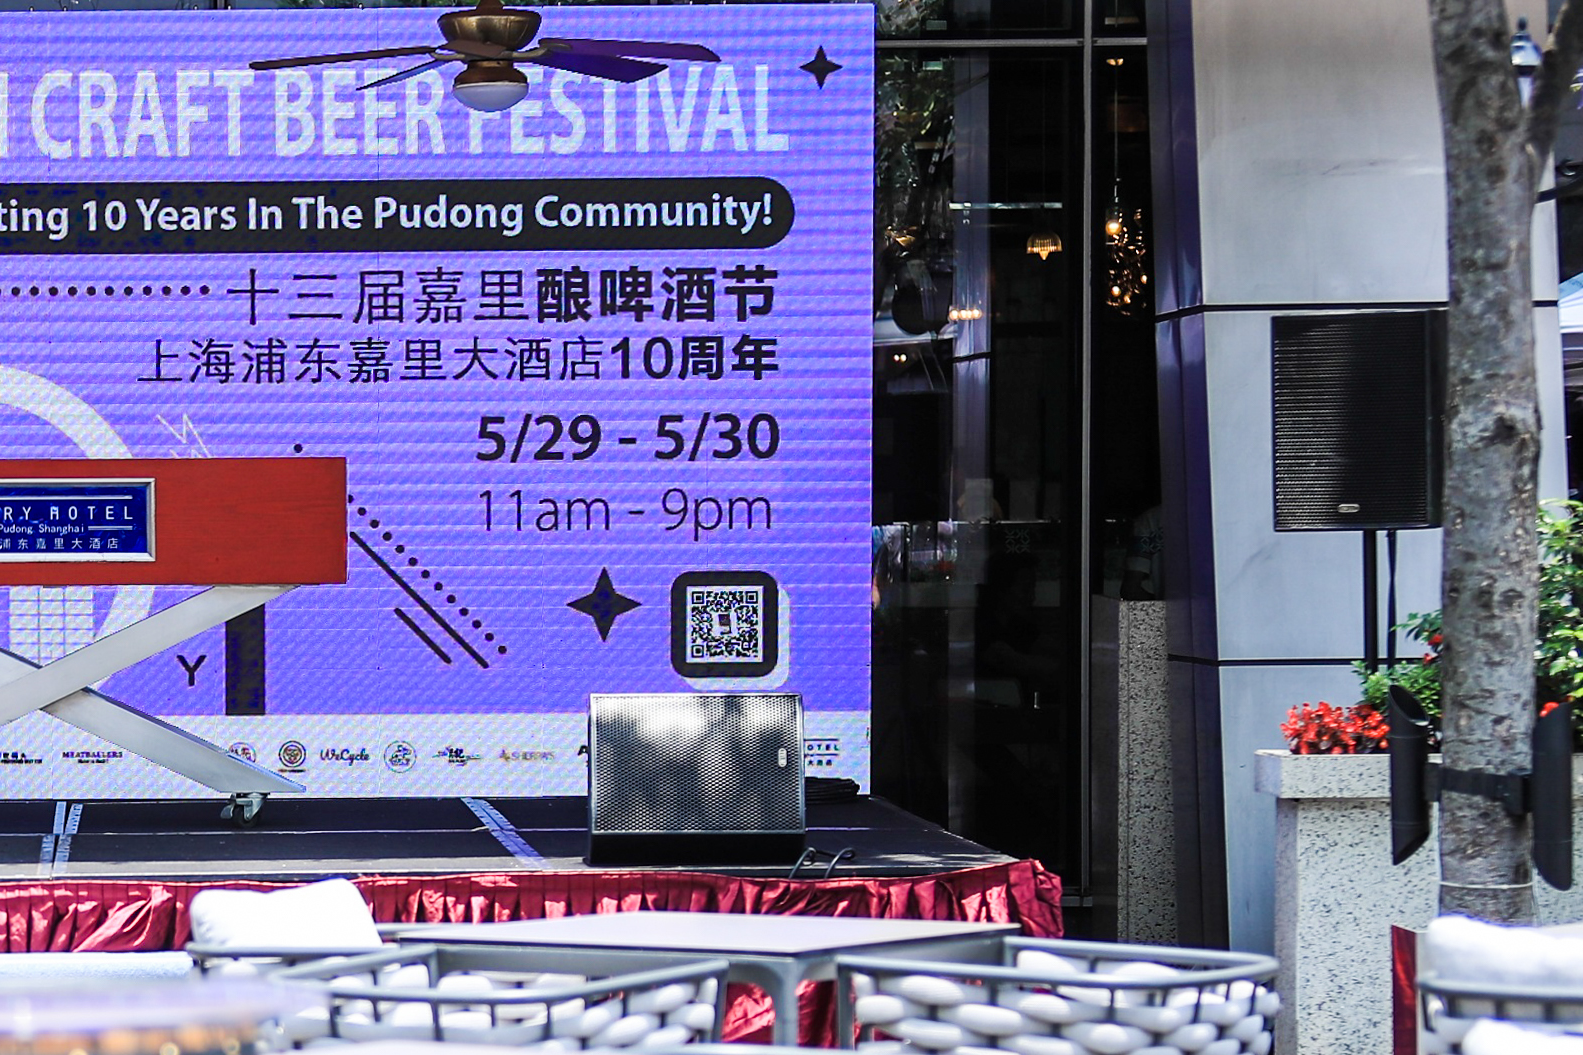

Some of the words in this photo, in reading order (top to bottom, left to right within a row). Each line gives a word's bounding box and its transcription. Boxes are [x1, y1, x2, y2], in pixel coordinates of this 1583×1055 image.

[31, 70, 255, 159] CRAFT
[275, 66, 446, 157] BEER
[82, 201, 127, 232] 10
[136, 199, 238, 232] Years
[249, 199, 284, 231] In
[292, 197, 363, 231] The
[375, 196, 524, 238] Pudong
[535, 194, 774, 230] Community!
[226, 265, 780, 327] 十三届嘉里酿啤酒节
[137, 334, 780, 385] 上海浦东嘉里大酒店10周年
[477, 414, 603, 464] 5/29
[655, 412, 781, 463] 5/30
[38, 523, 84, 536] Shanghai
[50, 506, 134, 520] HOTEL
[479, 489, 611, 533] 11am
[662, 486, 773, 543] 9pm
[177, 655, 207, 688] Y
